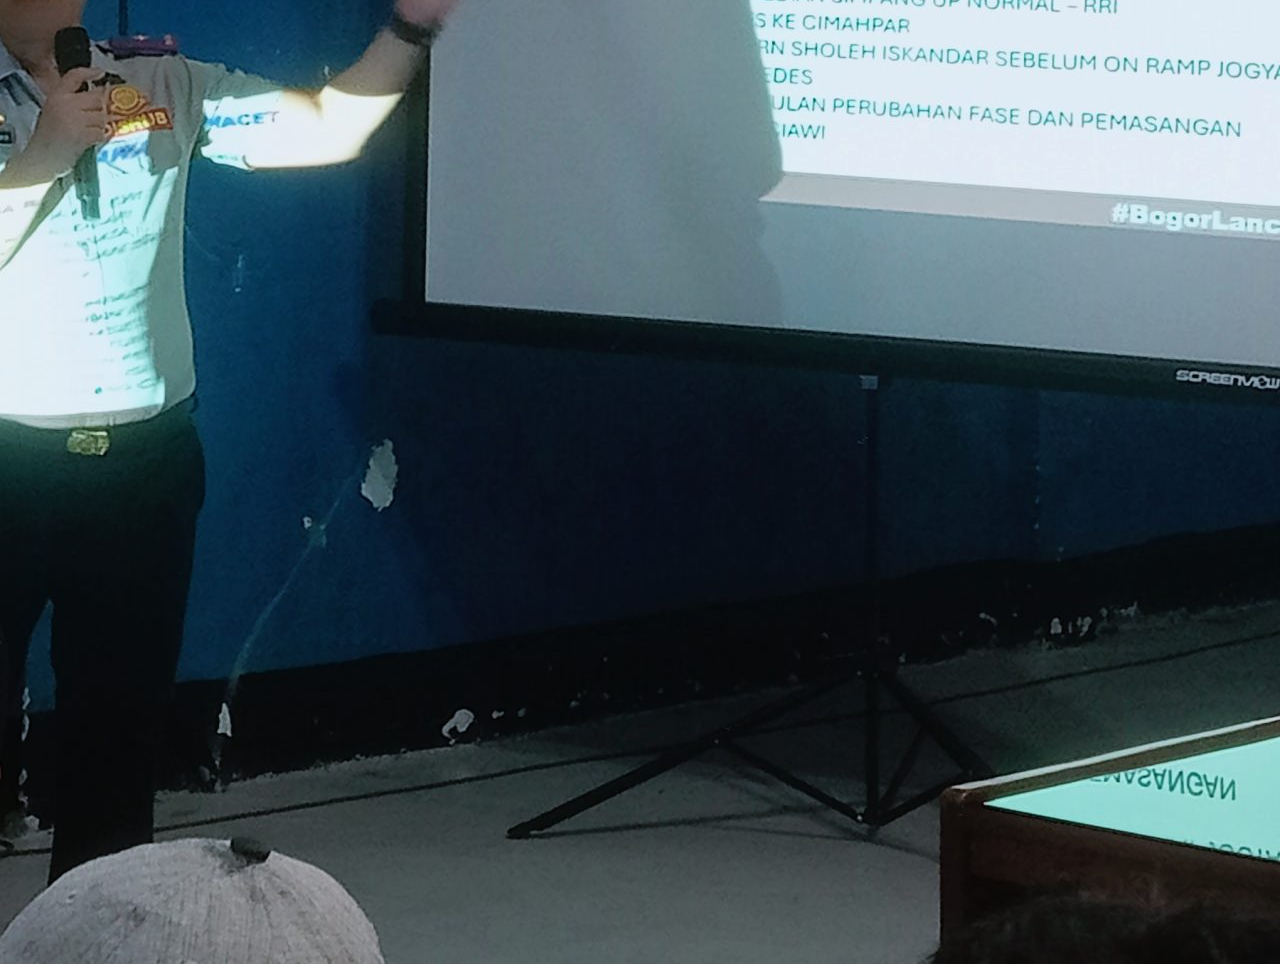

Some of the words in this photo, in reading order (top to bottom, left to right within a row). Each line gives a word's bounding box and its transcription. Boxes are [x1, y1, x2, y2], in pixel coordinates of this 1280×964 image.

[772, 14, 796, 30] KE
[801, 15, 911, 34] CIMAHPAR
[791, 41, 877, 60] SHOLEH
[882, 46, 989, 65] ISKANDAR
[995, 51, 1097, 71] SEBELUM
[1103, 56, 1139, 73] ON
[1145, 57, 1212, 76] RAMP
[775, 122, 826, 139] IAWI
[832, 98, 963, 121] PERUBAHAN
[969, 106, 1021, 126] FASE
[1027, 109, 1074, 128] DAN
[1080, 112, 1242, 138] PEMASANGAN
